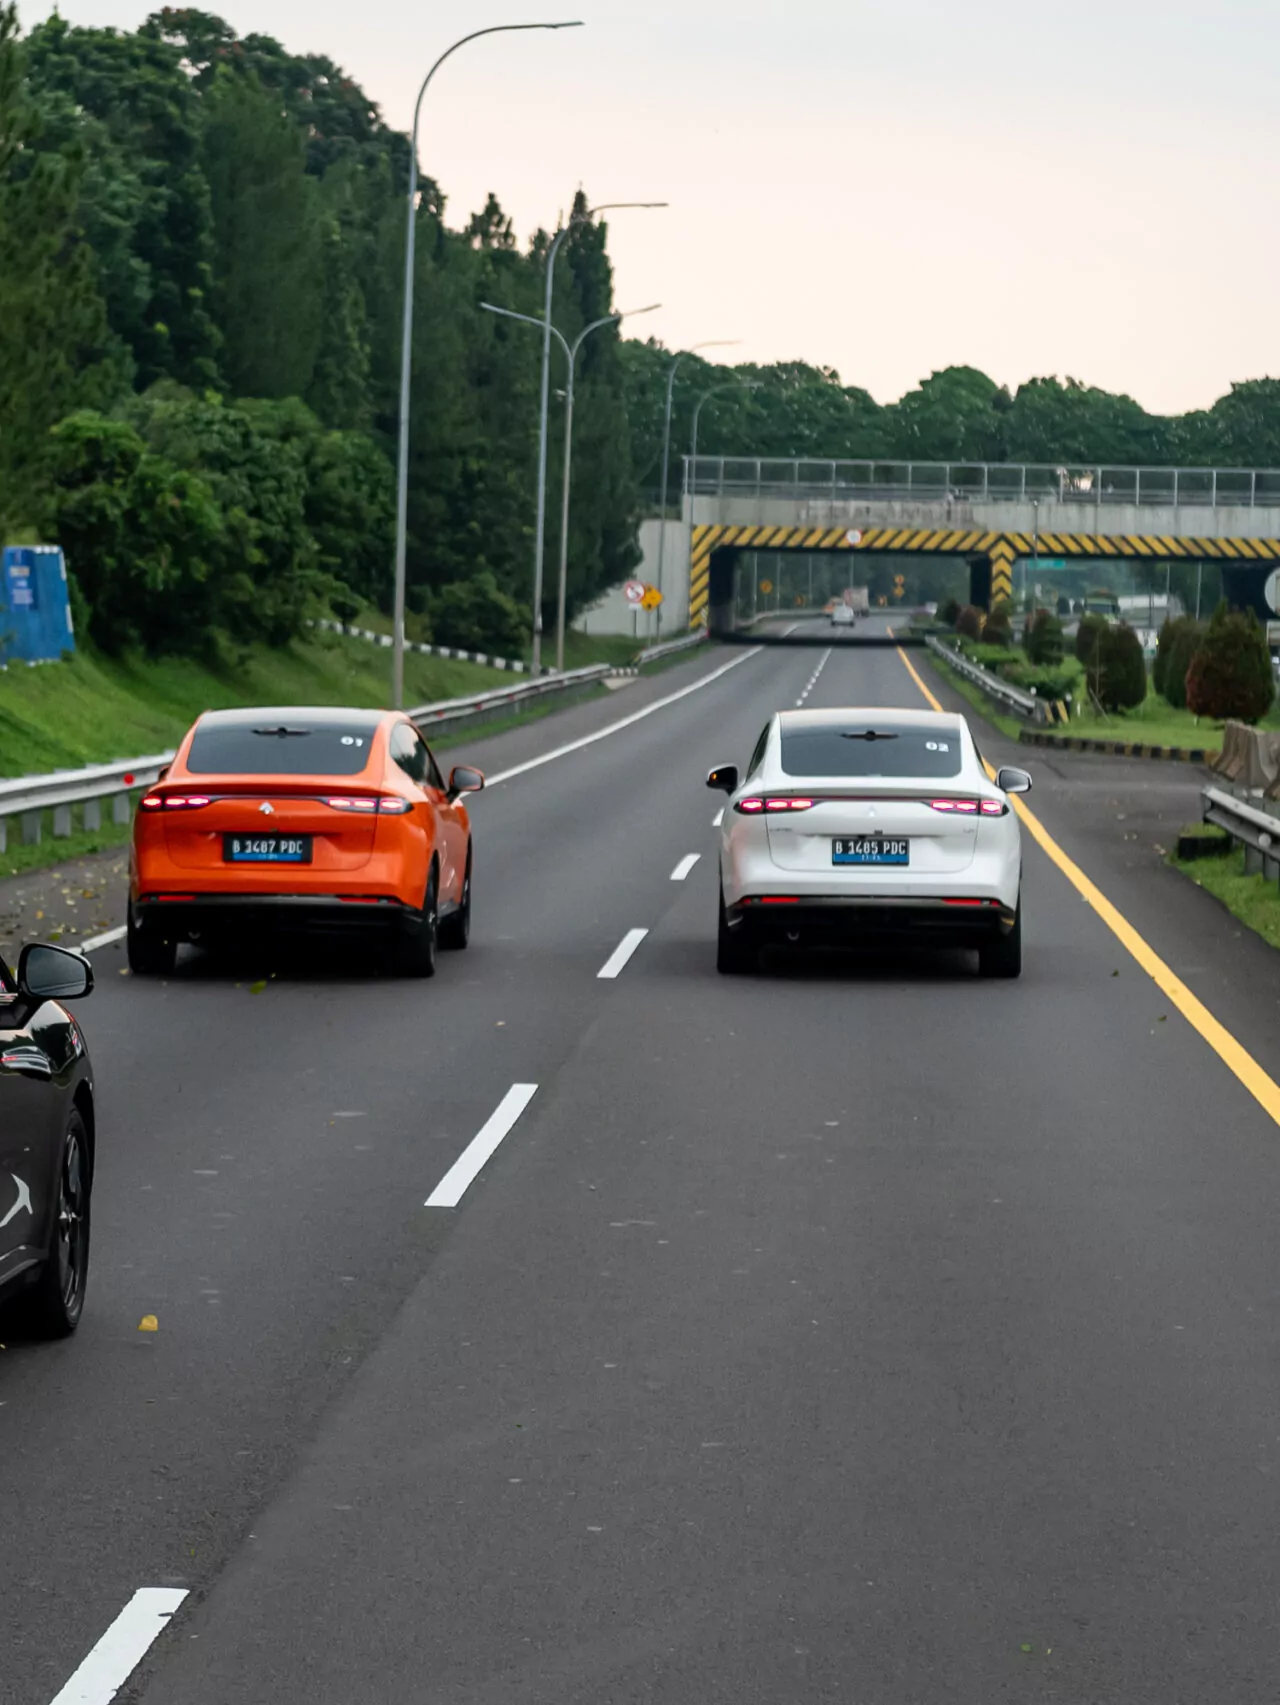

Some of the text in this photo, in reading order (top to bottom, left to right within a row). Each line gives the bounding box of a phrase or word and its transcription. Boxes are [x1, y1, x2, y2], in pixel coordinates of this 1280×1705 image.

[232, 839, 241, 853] B
[279, 839, 303, 853] PDC
[835, 840, 843, 854] B
[883, 841, 906, 854] PDC
